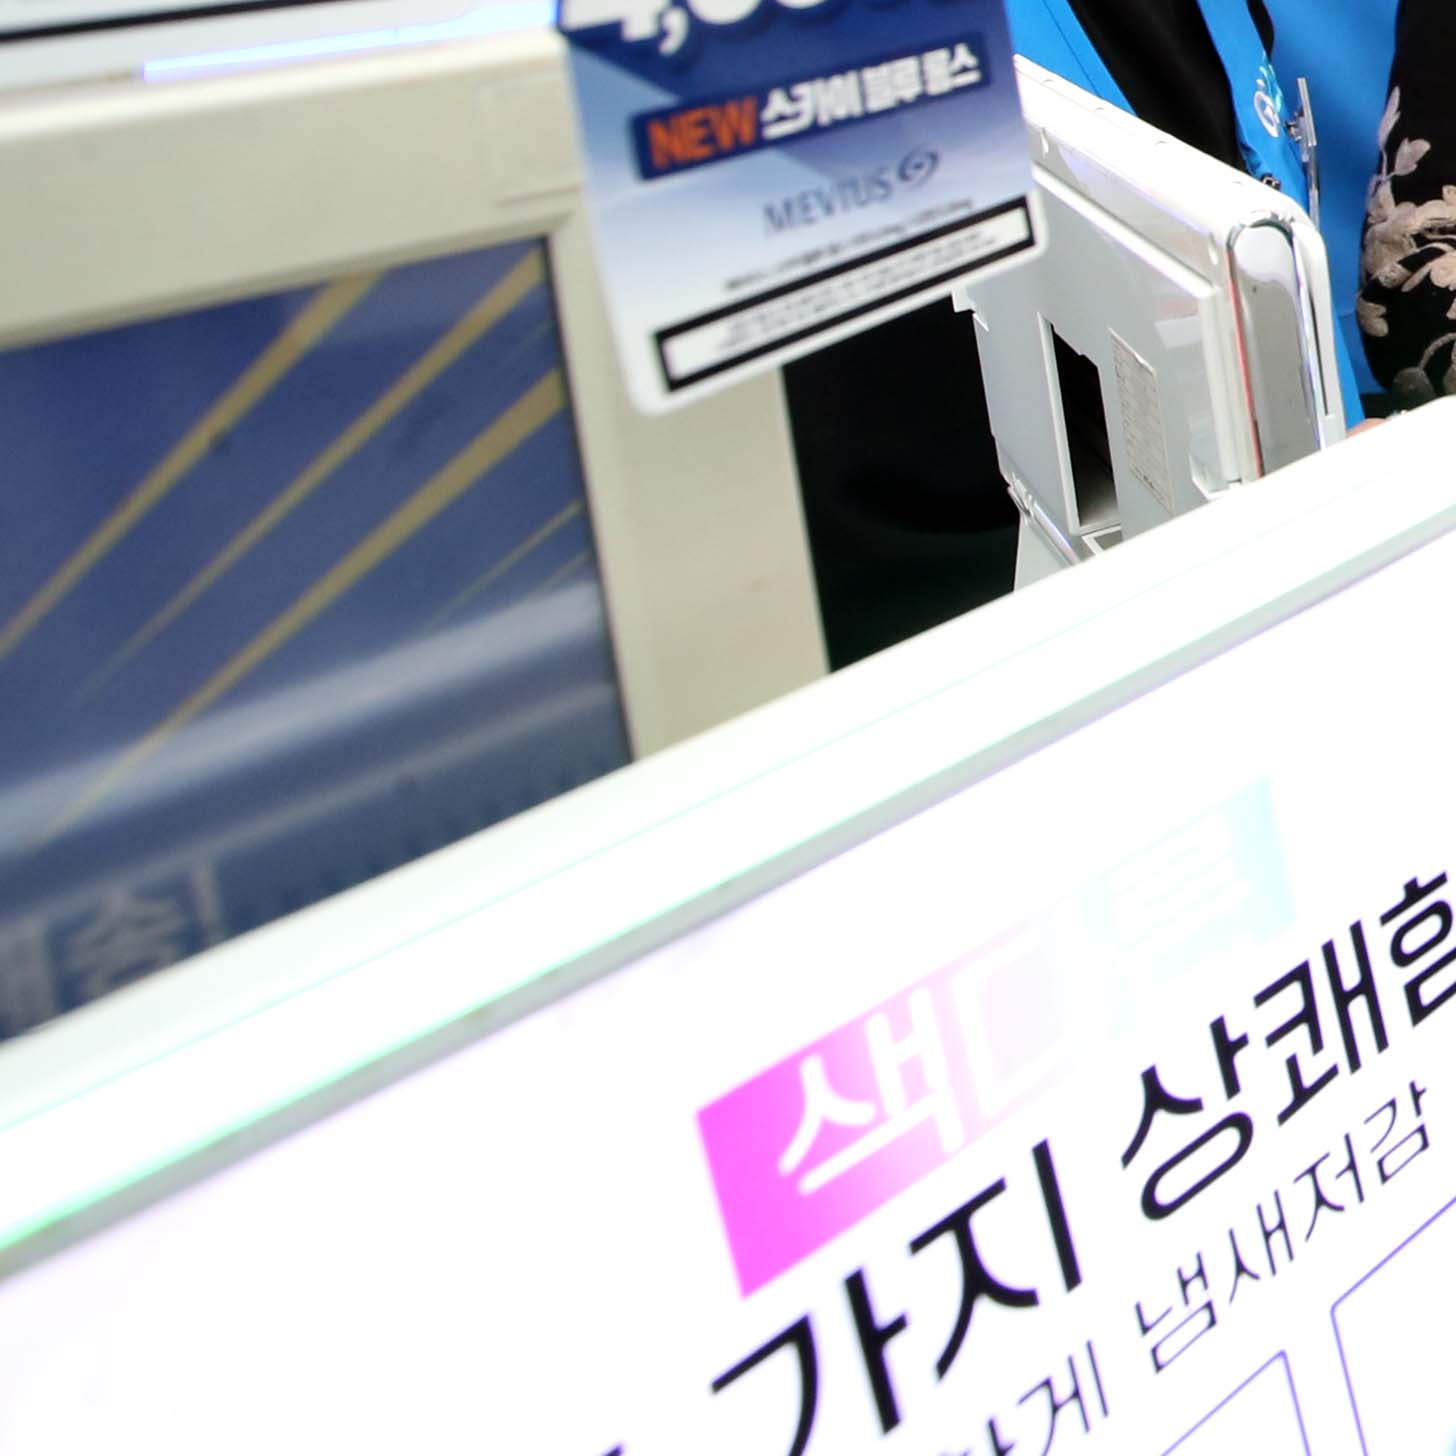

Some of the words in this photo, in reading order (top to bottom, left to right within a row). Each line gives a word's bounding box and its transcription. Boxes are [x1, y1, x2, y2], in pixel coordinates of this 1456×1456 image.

[648, 96, 758, 170] NEW
[762, 162, 895, 234] MEVIUS
[710, 1137, 1083, 1456] 가지
[1134, 1078, 1431, 1375] 냄새저감
